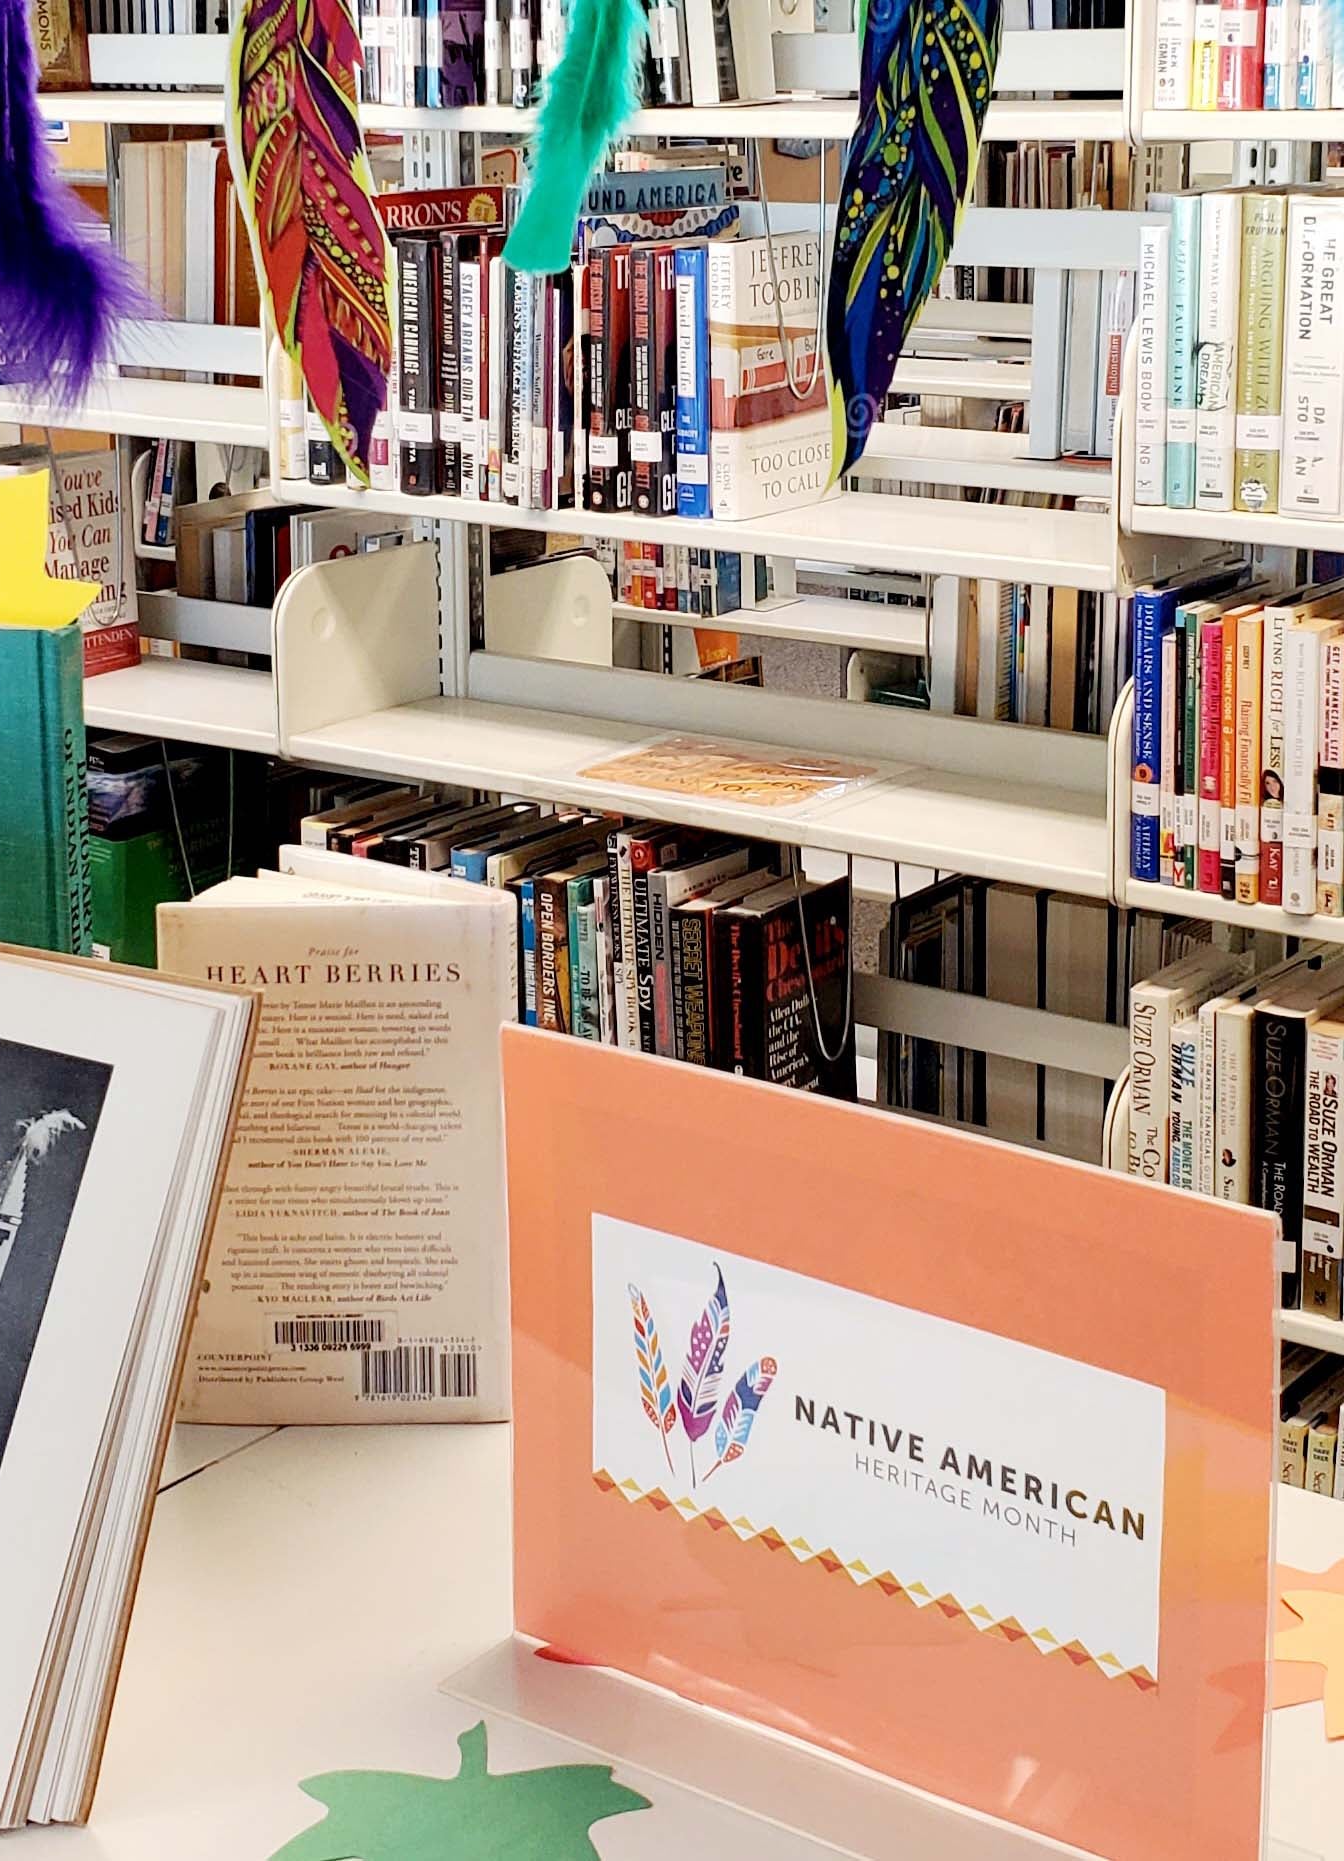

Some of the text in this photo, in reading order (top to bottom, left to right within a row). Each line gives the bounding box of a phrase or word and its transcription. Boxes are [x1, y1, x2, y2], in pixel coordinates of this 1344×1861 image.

[636, 183, 717, 211] AMERICA
[402, 261, 420, 376] AMERICAN CARNAGE
[1141, 243, 1154, 366] MICHAEL LEWIS
[1320, 267, 1336, 326] GREAT
[460, 273, 474, 404] STACEY ABRAMS OUR
[1175, 303, 1184, 358] FAULT
[463, 452, 474, 480] NOW
[752, 442, 832, 476] TOO CLOSE
[761, 474, 822, 501] TO CALL
[82, 523, 111, 549] Can
[1270, 617, 1286, 770] LIVING RICH LESS
[1143, 704, 1153, 760] SENSE
[1268, 846, 1281, 872] KAY
[308, 946, 360, 958] Praise for
[540, 892, 556, 996] OPEN BORDERS
[622, 902, 636, 993] ULTIMATE SPY
[634, 878, 649, 969] ULTIMATE
[682, 918, 702, 980] SECRET
[207, 963, 462, 985] HEART BERRIES
[1132, 1002, 1157, 1116] SUZE ORMAN
[1170, 1044, 1183, 1104] ORMAN
[1181, 1042, 1196, 1089] SUZE
[1263, 1021, 1287, 1157] SUZE ORMAN
[1306, 1070, 1320, 1194] THE ROAD TO WEALTH
[1321, 1096, 1339, 1198] SUZE ORMAN
[1273, 1161, 1287, 1182] THE
[795, 1395, 1145, 1541] NATIVE AMERICAN
[855, 1452, 1077, 1547] HERITAGE MONTH
